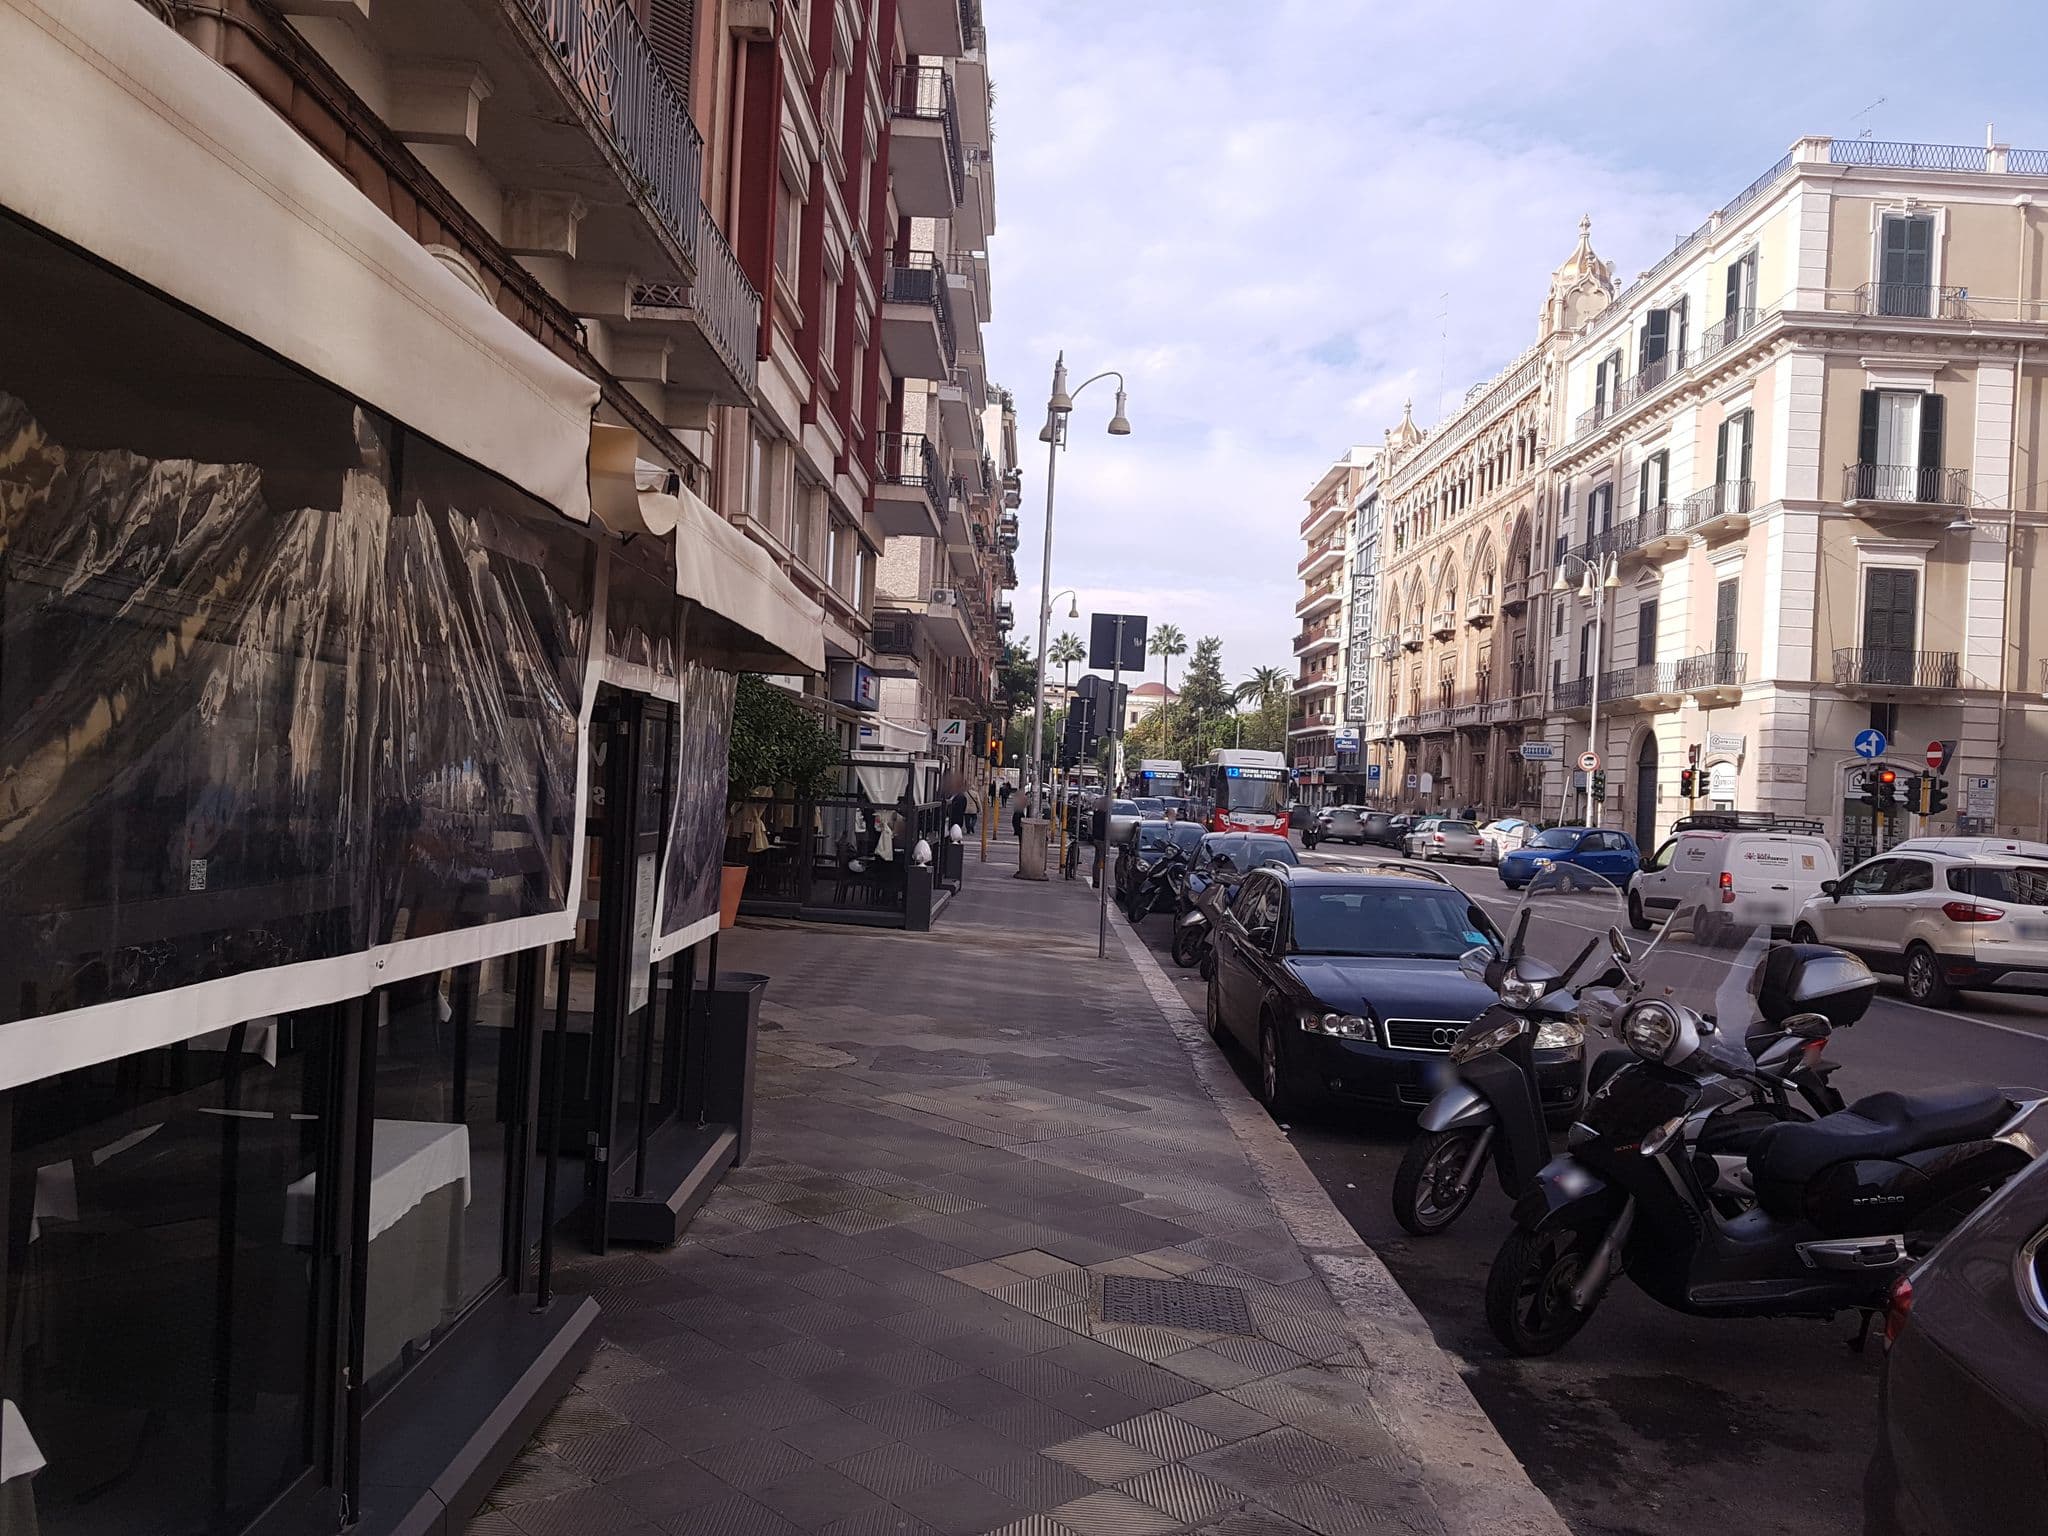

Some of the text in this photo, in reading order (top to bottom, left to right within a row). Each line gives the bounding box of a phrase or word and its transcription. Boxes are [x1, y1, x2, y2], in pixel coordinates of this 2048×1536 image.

[1349, 577, 1371, 719] EXECUTIVE
[1523, 747, 1553, 755] PIZZERIA
[1227, 767, 1239, 777] 13
[1291, 769, 1298, 777] P
[1370, 766, 1379, 776] P
[1980, 779, 1987, 788] P
